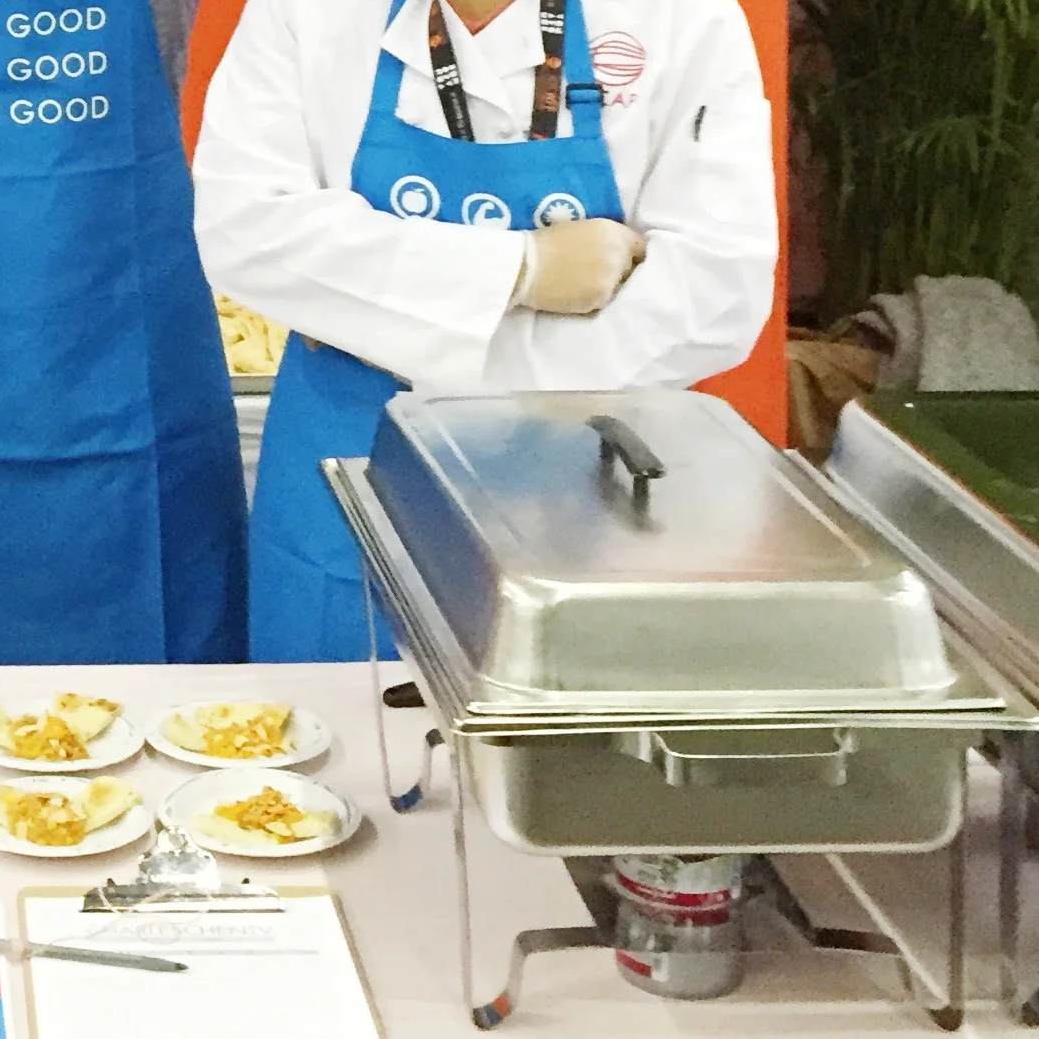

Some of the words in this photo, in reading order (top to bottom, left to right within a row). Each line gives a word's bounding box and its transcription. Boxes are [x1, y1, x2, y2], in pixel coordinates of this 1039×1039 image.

[6, 6, 107, 38] GOOD
[6, 51, 108, 81] GOOD
[10, 95, 109, 125] GOOD
